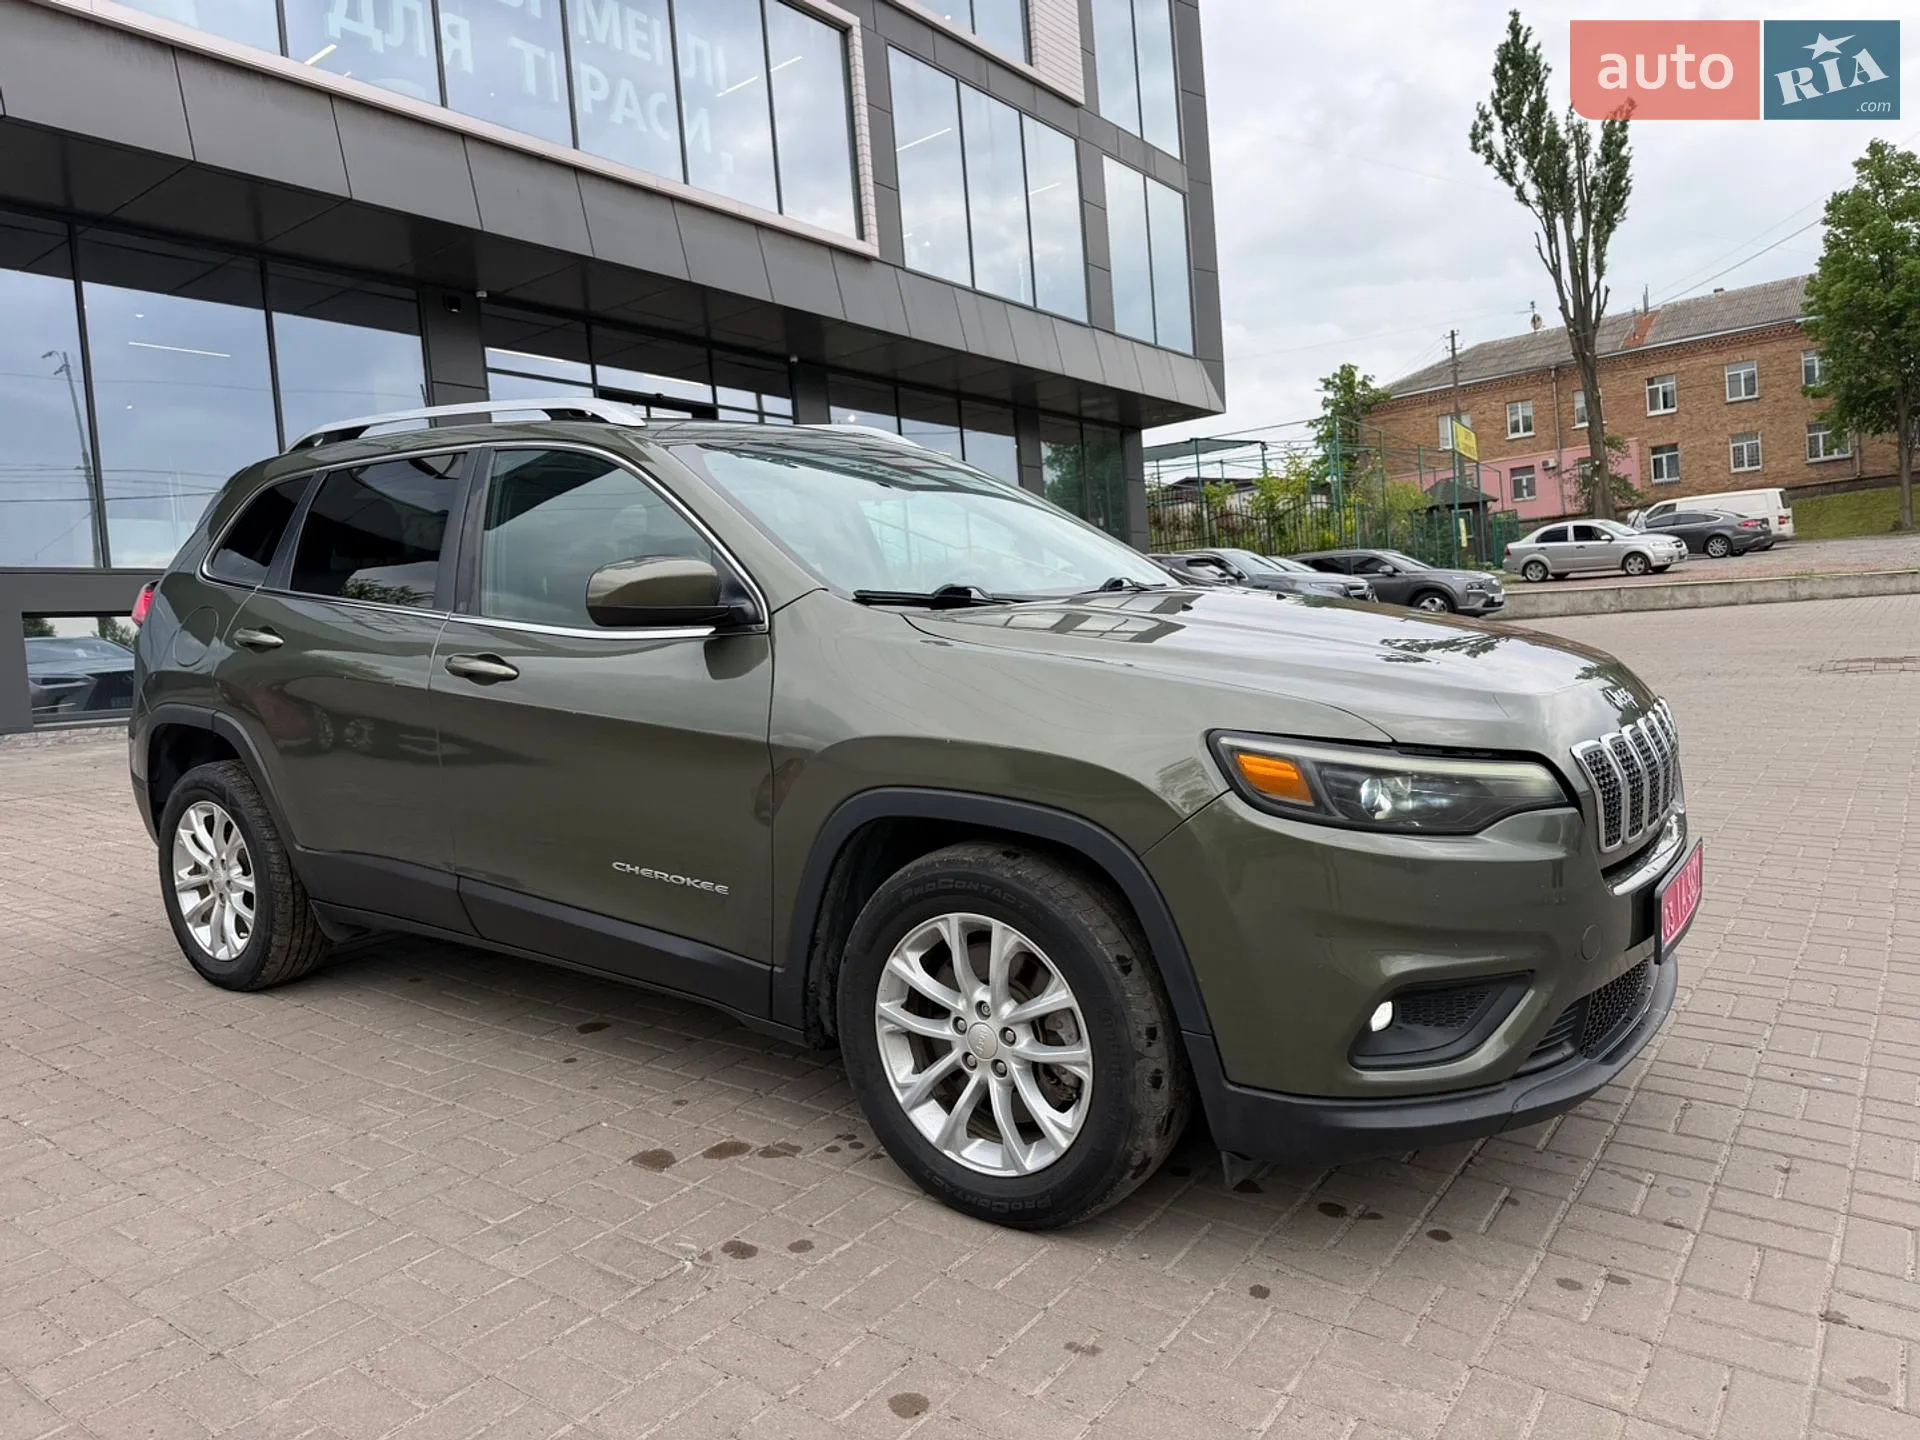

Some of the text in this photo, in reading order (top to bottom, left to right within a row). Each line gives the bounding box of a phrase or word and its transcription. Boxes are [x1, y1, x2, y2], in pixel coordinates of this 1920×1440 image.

[323, 0, 473, 74] ДЛЯ
[577, 0, 727, 90] МЕЛІ
[611, 861, 730, 895] CHEROKEE
